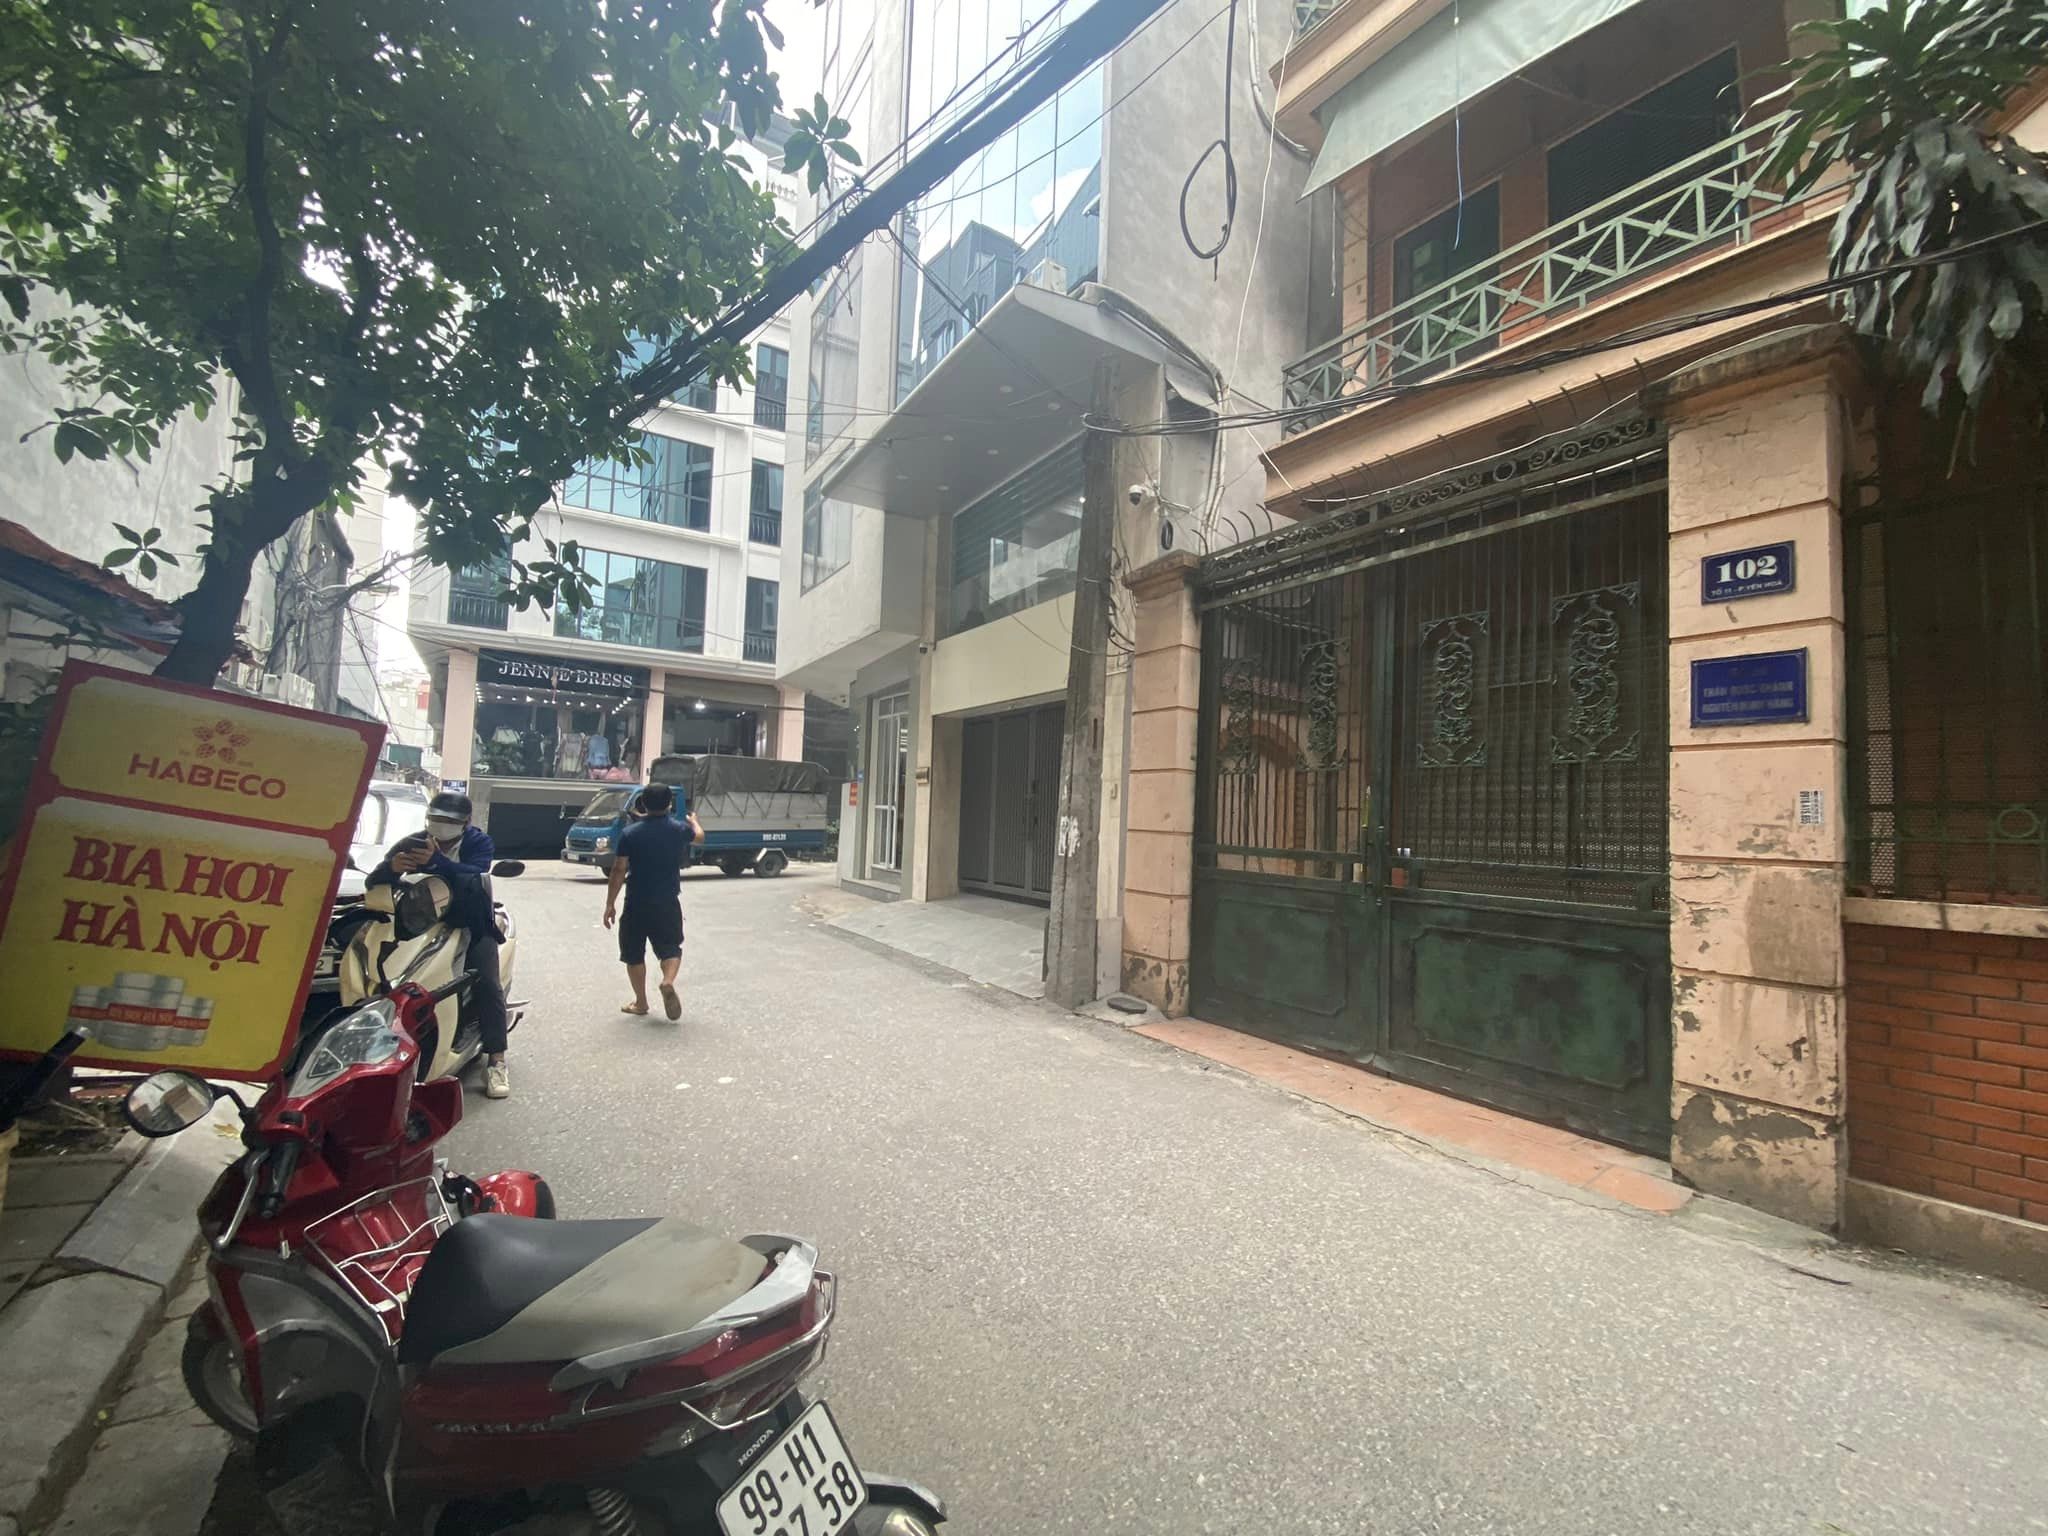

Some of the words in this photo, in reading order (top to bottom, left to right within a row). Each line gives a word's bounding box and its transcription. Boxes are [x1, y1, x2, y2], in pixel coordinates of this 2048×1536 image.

[1717, 555, 1778, 584] 102
[576, 669, 633, 688] DRESS
[128, 752, 287, 799] HABECO
[63, 835, 168, 891] BIA
[173, 853, 294, 907] HƠI
[53, 895, 146, 951] HÀ
[151, 910, 271, 971] NỘI
[738, 1428, 775, 1466] HONDA
[739, 1421, 827, 1535] 99-H1
